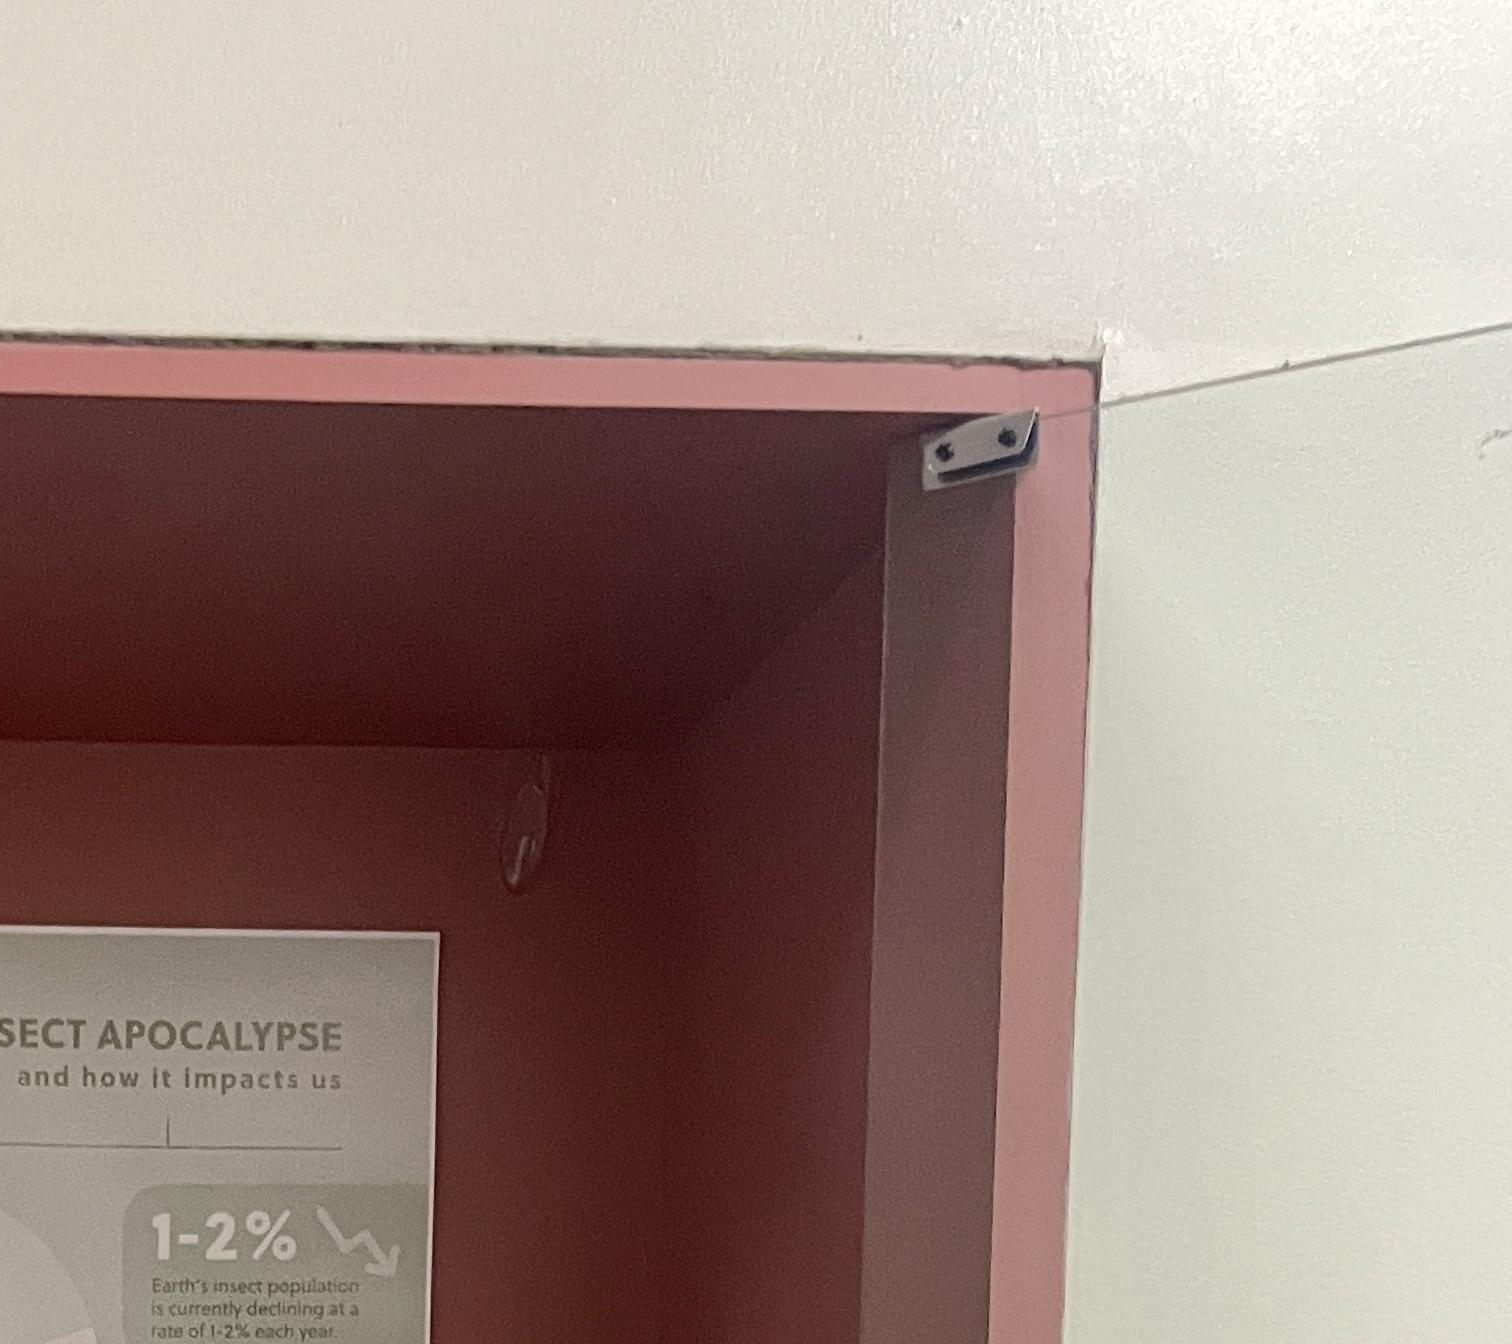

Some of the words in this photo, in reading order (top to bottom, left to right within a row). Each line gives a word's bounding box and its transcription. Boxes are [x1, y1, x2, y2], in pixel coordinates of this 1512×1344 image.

[97, 1020, 341, 1051] APOCALYPSE
[18, 1065, 68, 1087] and
[82, 1066, 138, 1087] how
[152, 1067, 170, 1089] it
[184, 1068, 297, 1095] impacts
[312, 1074, 340, 1089] us
[152, 1211, 296, 1260] 1-2%
[152, 1278, 208, 1294] Earth's
[213, 1281, 262, 1297] insect
[267, 1278, 359, 1298] population
